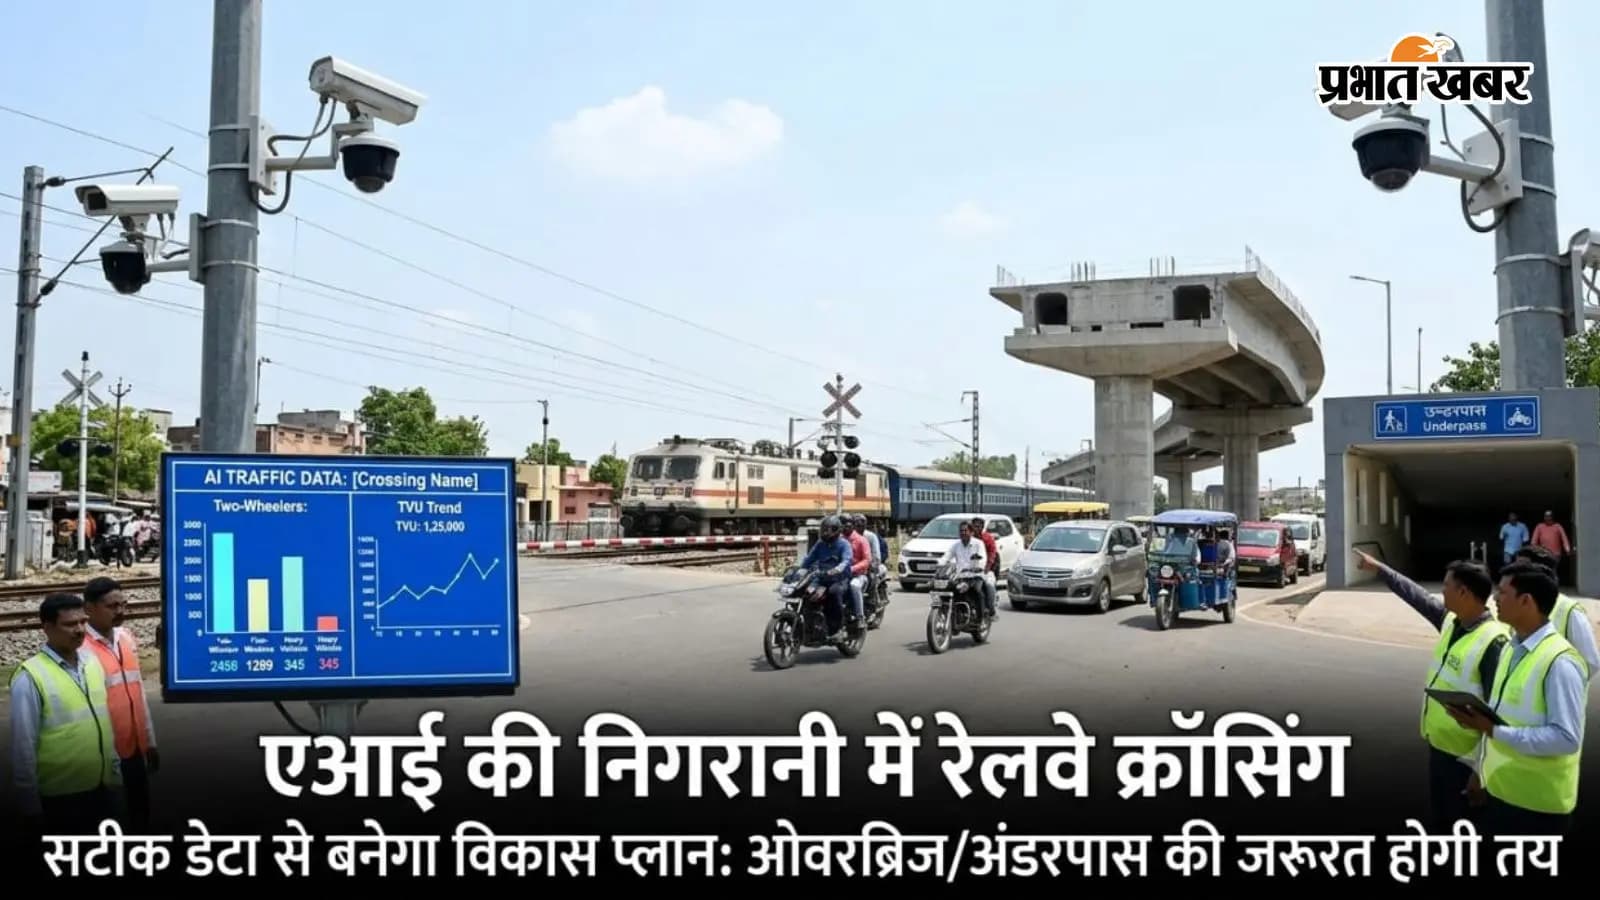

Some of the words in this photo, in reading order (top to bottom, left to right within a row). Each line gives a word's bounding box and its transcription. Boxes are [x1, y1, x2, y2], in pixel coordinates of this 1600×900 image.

[1423, 420, 1487, 433] Underpass
[204, 469, 222, 485] AI
[226, 469, 296, 486] TRAFFIC
[301, 470, 348, 486] DATA:
[352, 471, 426, 490] [Crossing
[430, 473, 478, 491] Name]
[213, 499, 308, 513] Two-Wheelers:
[397, 501, 423, 513] TVU
[426, 501, 462, 514] Trend
[395, 521, 421, 532] TVU:
[423, 521, 465, 533] 1,25,000
[284, 659, 305, 671] 345
[319, 658, 340, 670] 345
